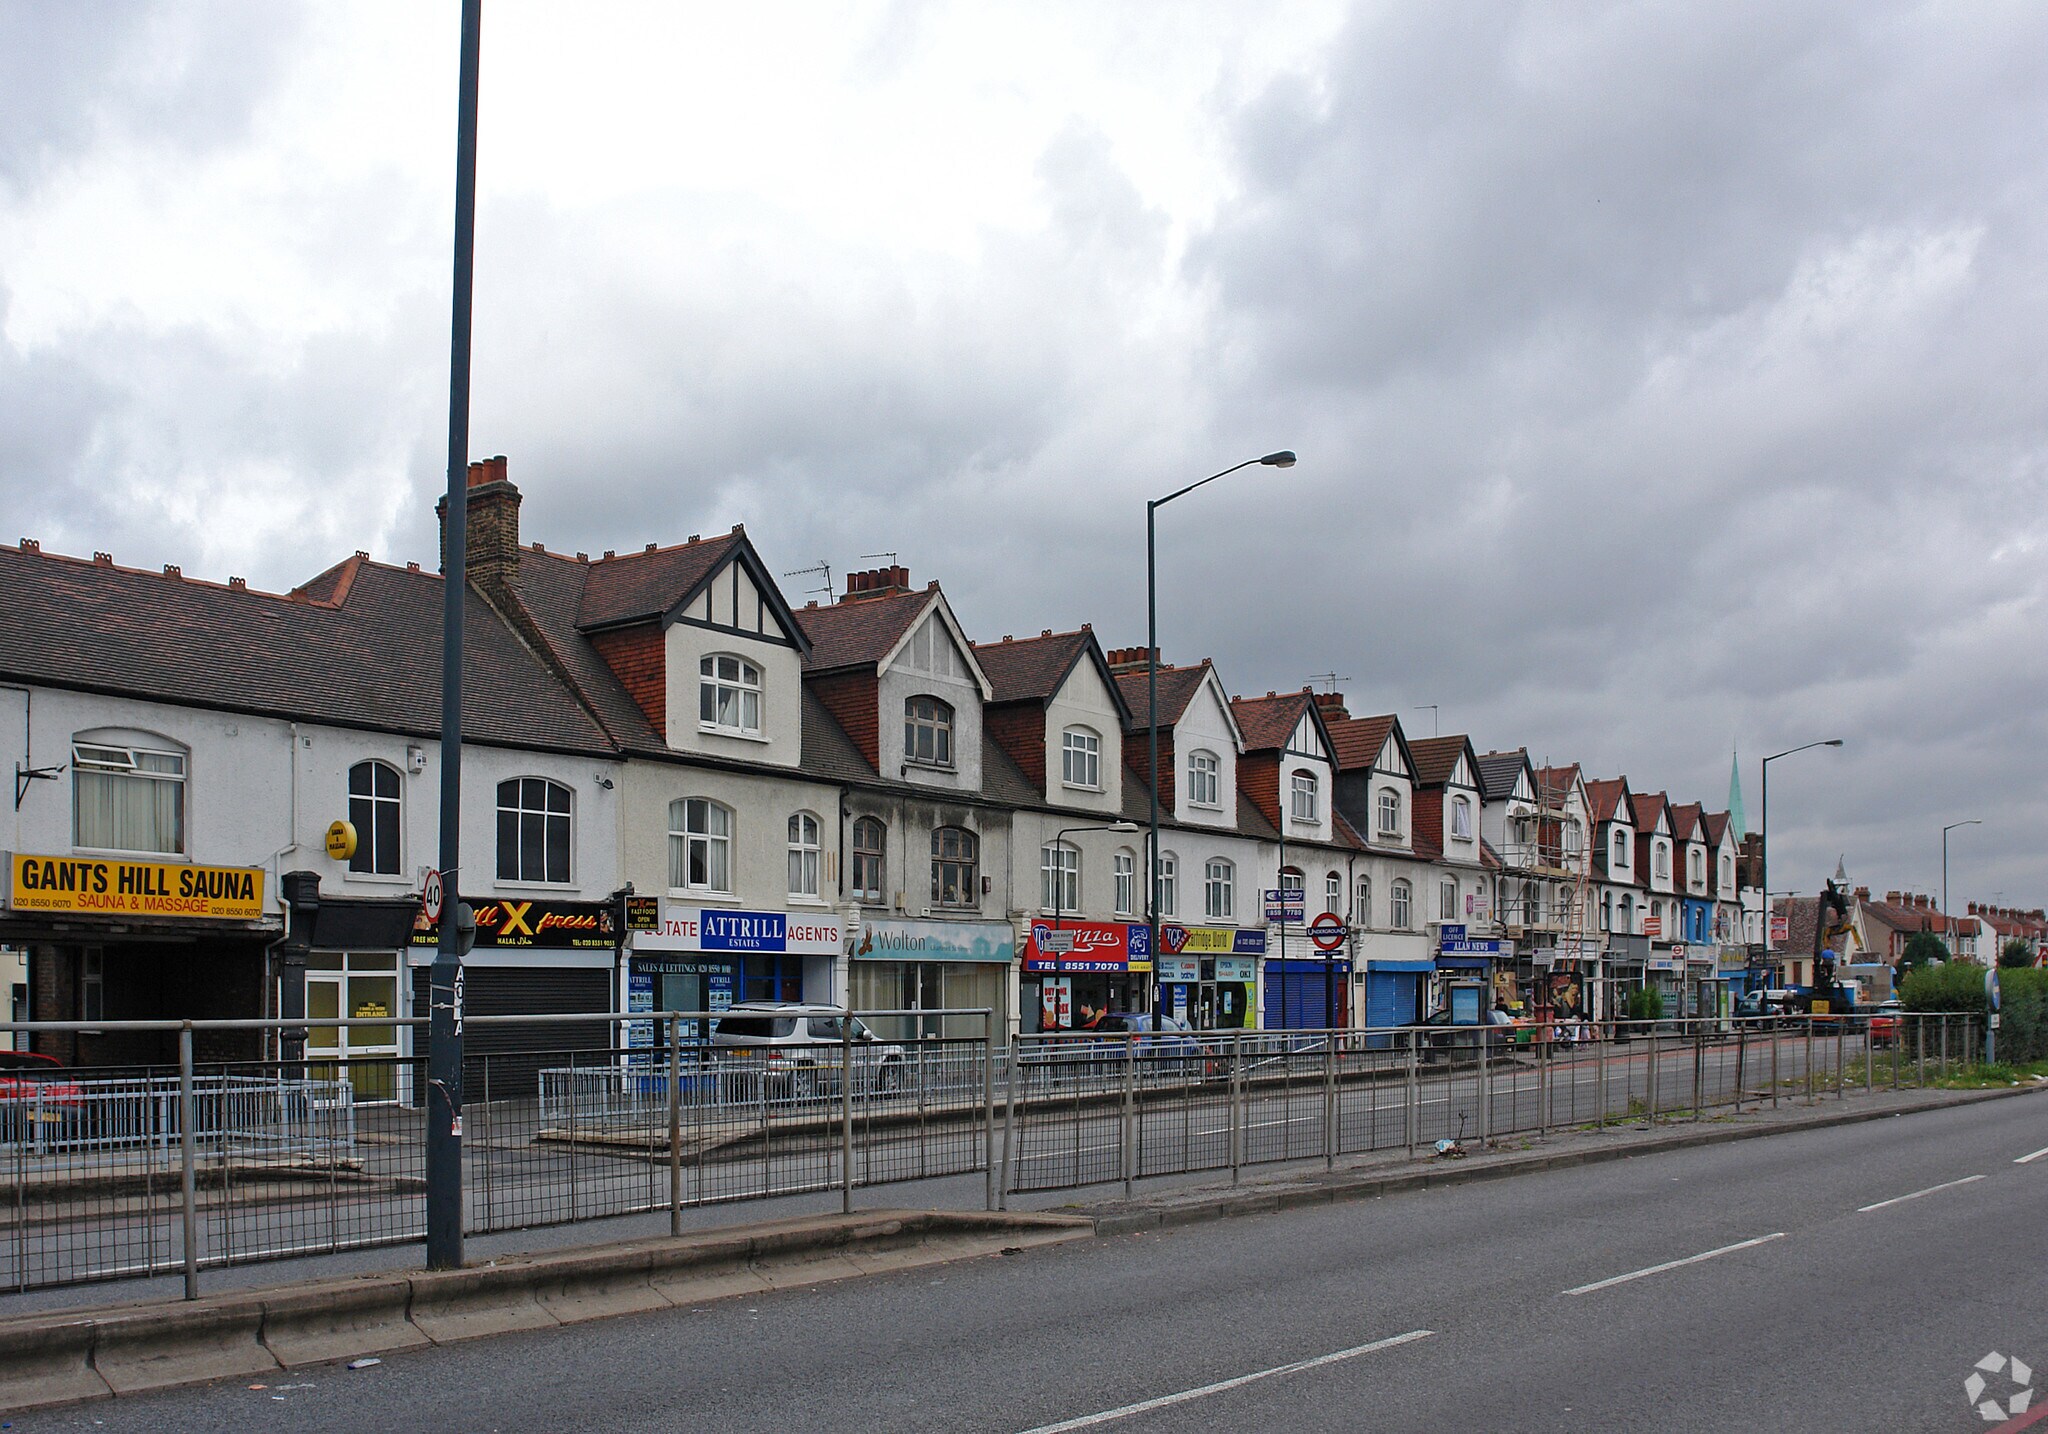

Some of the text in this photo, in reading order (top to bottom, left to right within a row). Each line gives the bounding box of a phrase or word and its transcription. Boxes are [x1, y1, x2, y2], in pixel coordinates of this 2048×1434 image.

[22, 859, 255, 900] GANTS HILL SAUNA
[426, 885, 440, 906] 40
[13, 897, 72, 908] 020 8550 6070
[77, 894, 208, 913] SAUNA & MASSAGE
[211, 906, 261, 916] 020 8550 6070
[704, 916, 783, 939] ATTRILL
[1308, 927, 1346, 936] UNDERGROUND
[788, 926, 838, 942] AGENTS
[1213, 930, 1227, 947] World
[729, 938, 760, 948] ESTATES
[878, 930, 926, 951] Wolton
[1454, 942, 1470, 951] ALAN
[1472, 942, 1489, 951] NEWS
[638, 963, 658, 973] SALES
[666, 963, 696, 973] LETTINGS
[630, 976, 652, 984] ATTRILL
[710, 976, 731, 984] ATTRILL
